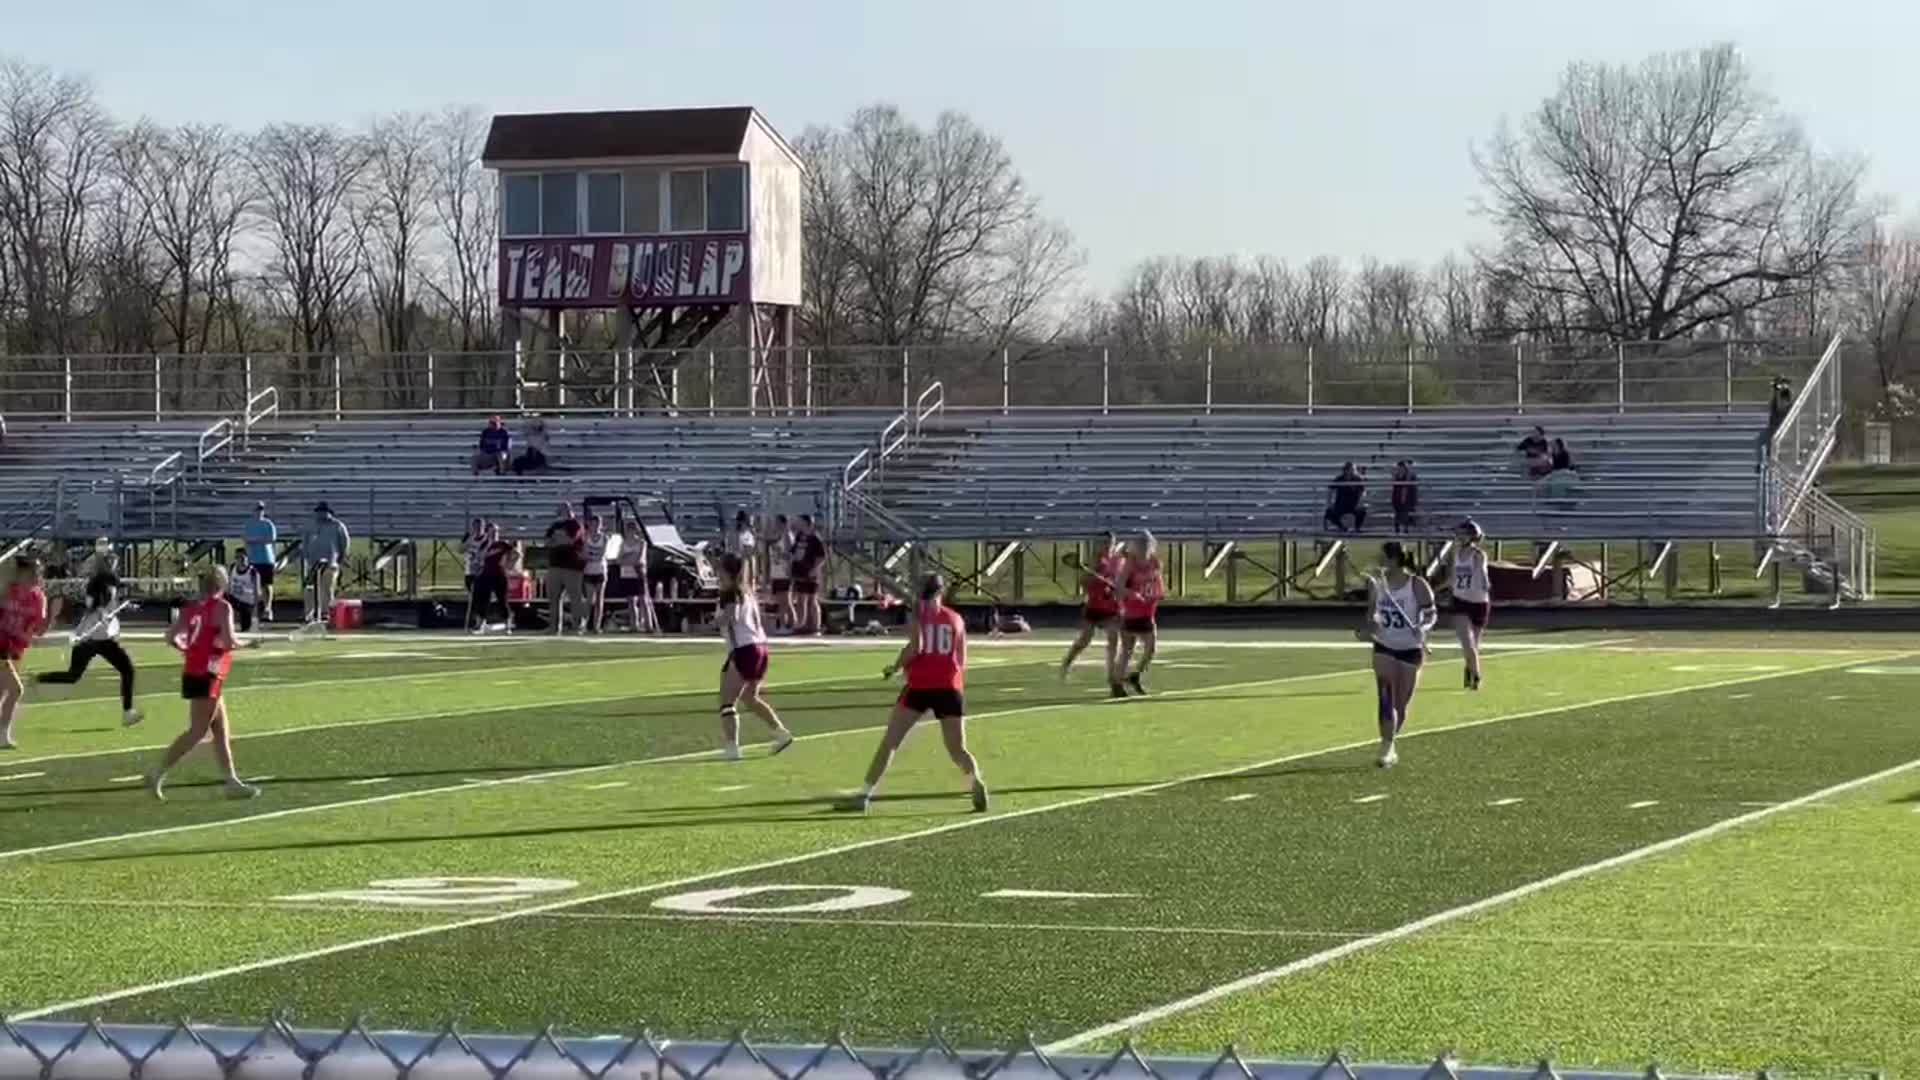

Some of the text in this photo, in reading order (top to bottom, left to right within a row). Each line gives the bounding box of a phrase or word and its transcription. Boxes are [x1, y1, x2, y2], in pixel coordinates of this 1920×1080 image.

[506, 240, 745, 300] TEAM DUNLAP
[1379, 609, 1405, 629] 33
